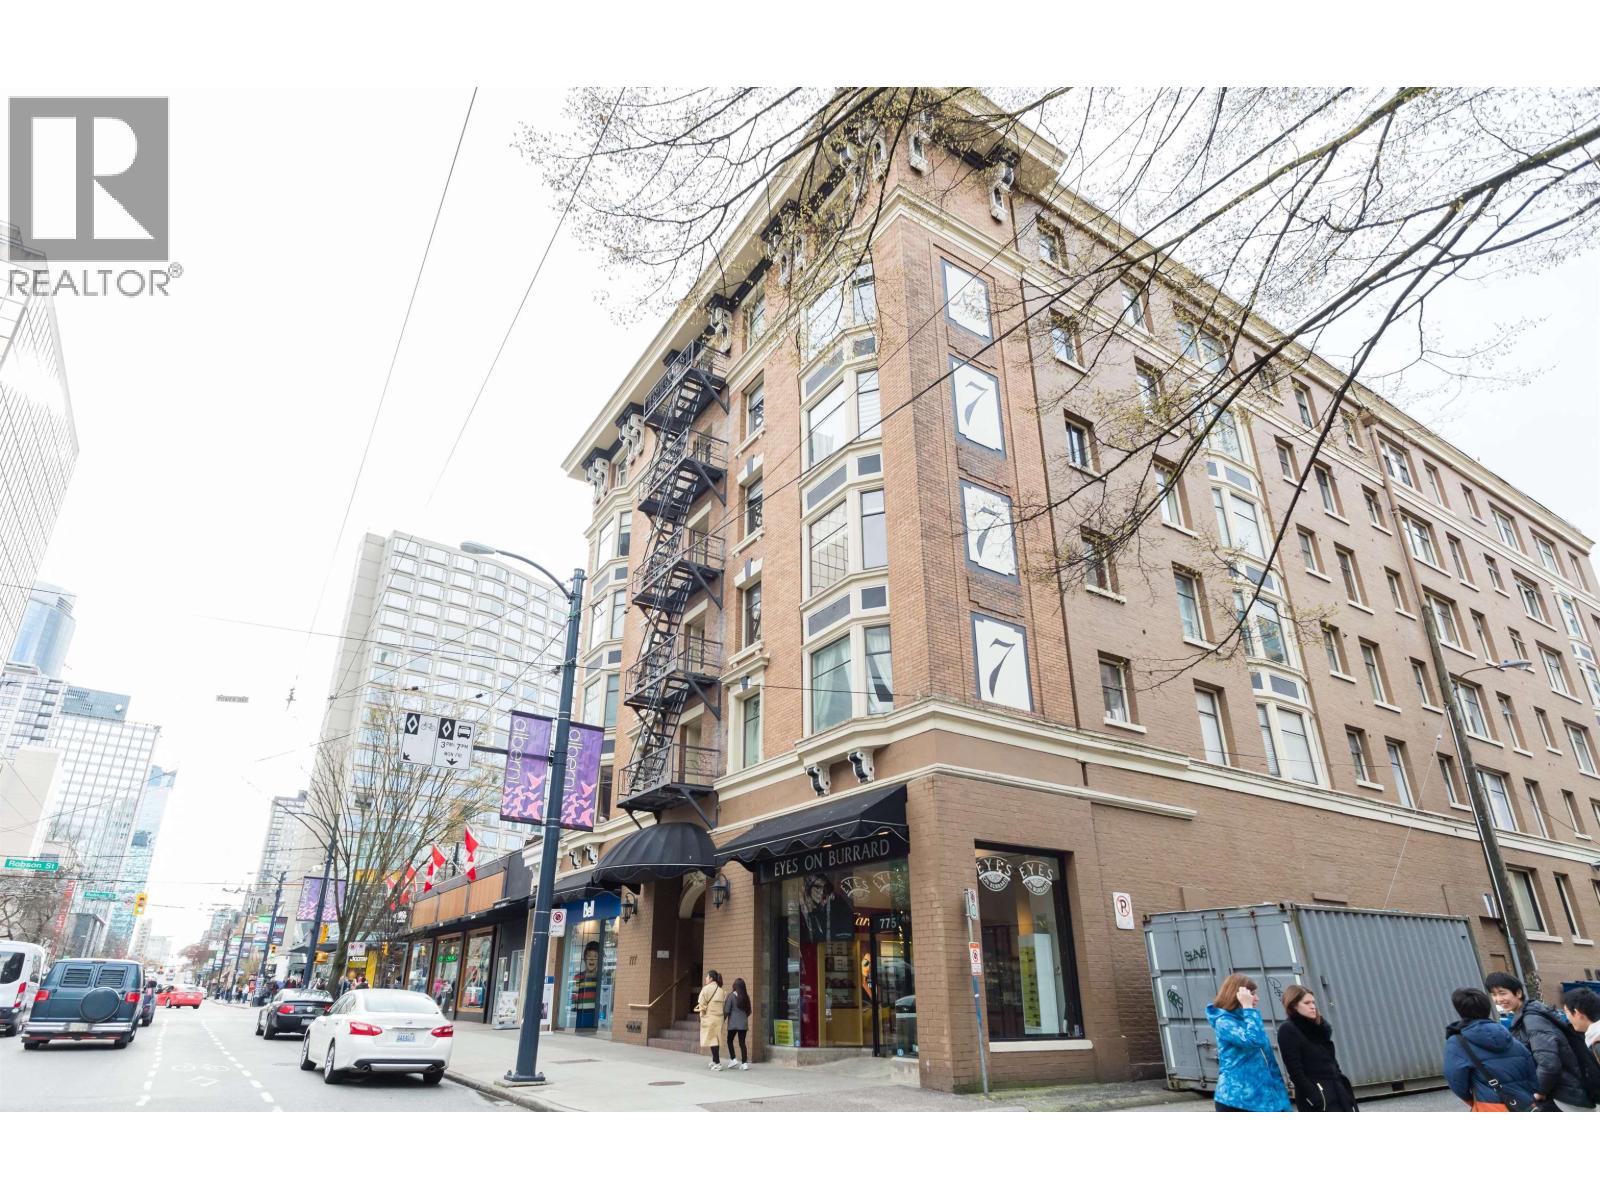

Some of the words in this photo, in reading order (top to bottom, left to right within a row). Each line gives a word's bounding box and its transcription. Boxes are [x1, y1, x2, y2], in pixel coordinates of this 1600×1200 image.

[964, 381, 989, 427] 7
[977, 506, 1002, 558] 7
[989, 637, 1016, 698] 7
[507, 719, 530, 784] alberni
[564, 729, 583, 792] alberni
[8, 860, 42, 868] Robson
[774, 858, 799, 877] EYES
[804, 853, 823, 871] ON
[828, 839, 890, 866] BURRARD
[976, 858, 1012, 876] EYES
[1019, 863, 1054, 881] EYES
[840, 878, 869, 895] EYES
[583, 900, 595, 918] Bell
[880, 918, 897, 929] 775
